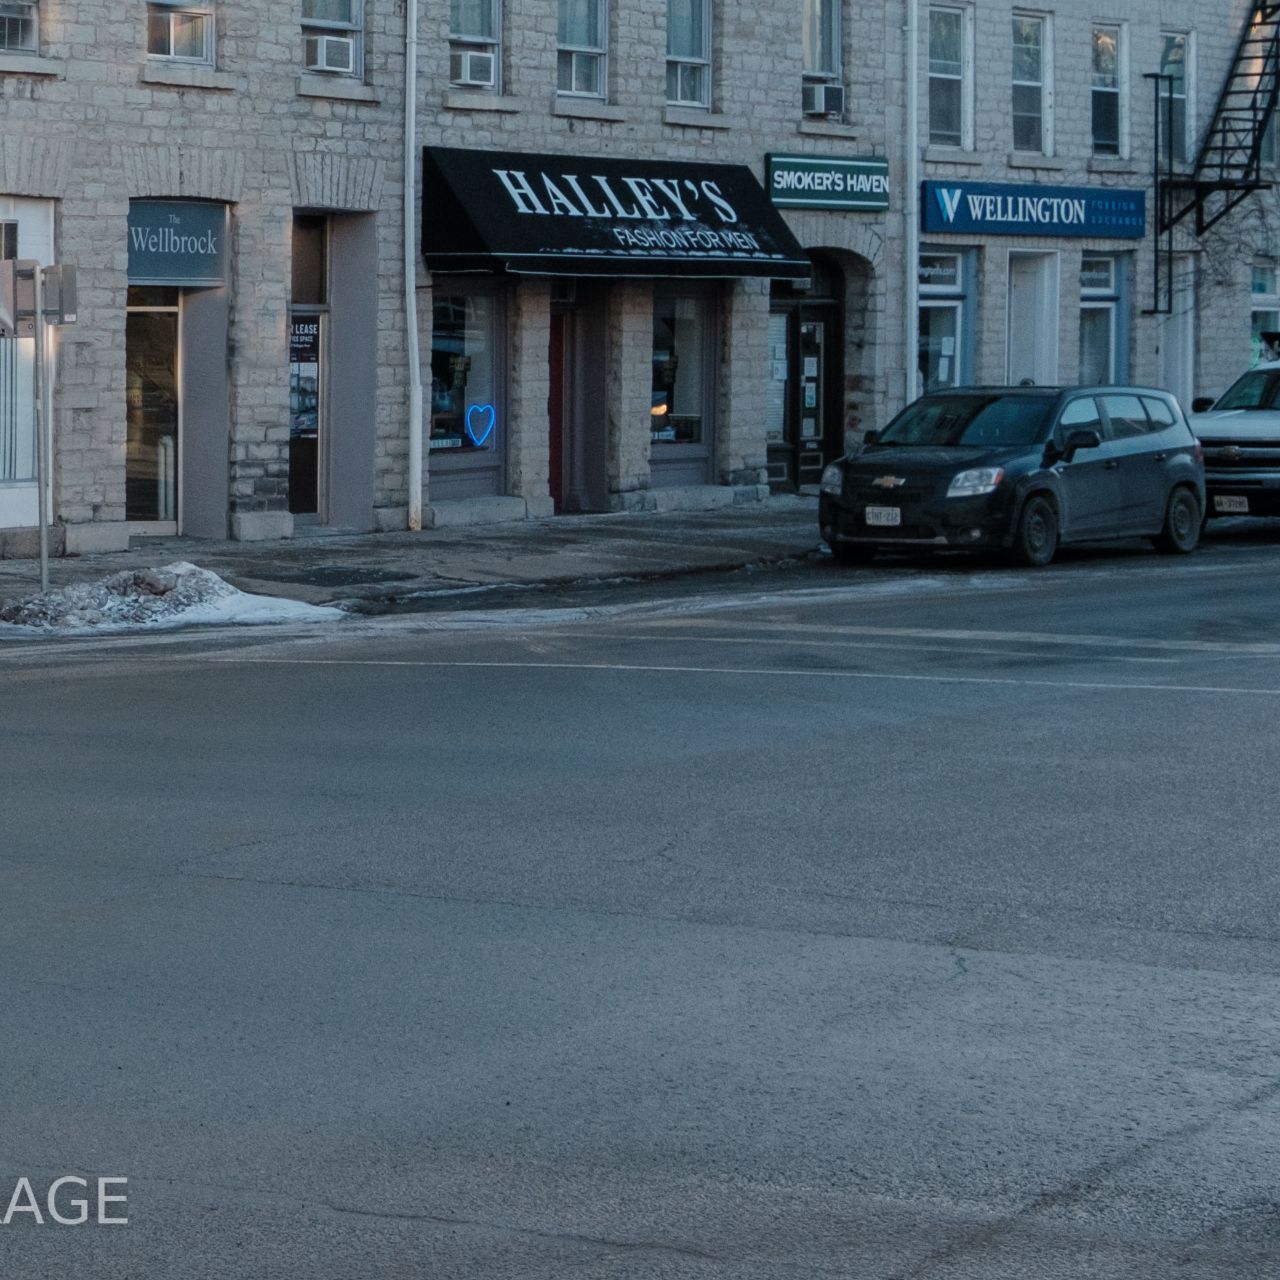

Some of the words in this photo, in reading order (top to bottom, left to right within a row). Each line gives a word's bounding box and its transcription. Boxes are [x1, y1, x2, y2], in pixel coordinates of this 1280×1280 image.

[773, 170, 844, 191] SMOKER'S
[846, 174, 890, 192] HAVEN
[491, 169, 738, 223] HALLEY'S
[168, 214, 181, 224] The
[966, 194, 1085, 224] WELLINGTON
[129, 226, 217, 254] Wellbrock
[612, 228, 690, 248] FASHION
[689, 230, 727, 249] FOR
[724, 231, 761, 251] MEN
[295, 324, 318, 335] LEASE
